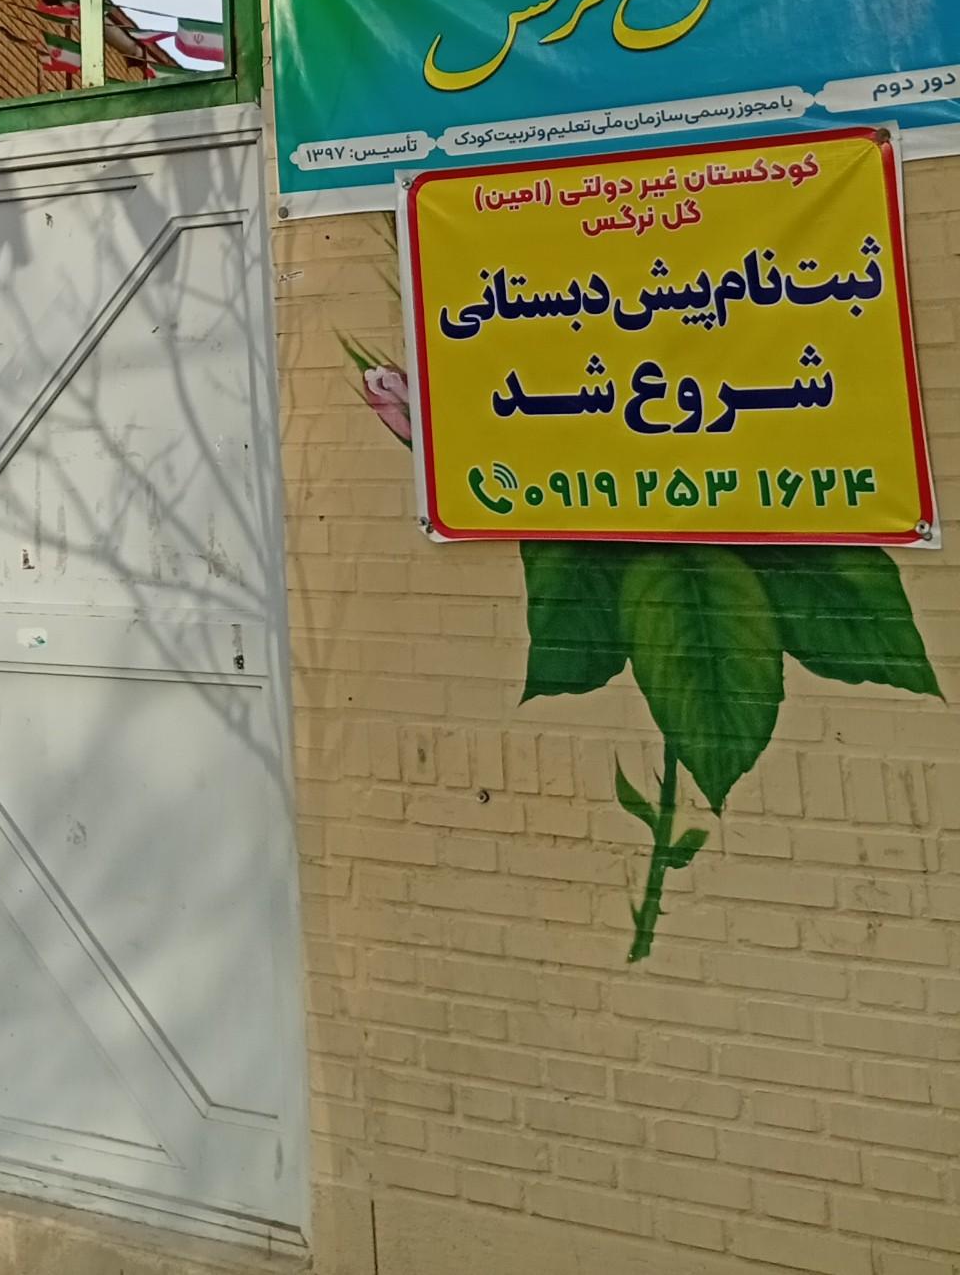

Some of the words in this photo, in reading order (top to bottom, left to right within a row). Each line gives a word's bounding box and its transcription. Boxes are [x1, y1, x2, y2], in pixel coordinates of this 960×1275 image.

[872, 78, 914, 100] دوم
[919, 72, 957, 94] دور
[684, 103, 737, 124] رسمی
[736, 98, 780, 118] مجوز
[779, 94, 793, 112] با
[493, 125, 538, 144] تربیت
[537, 128, 547, 141] و
[546, 118, 591, 142] تعلیم
[624, 110, 685, 131] سازمان
[453, 129, 495, 147] کودک
[305, 145, 346, 163] ۱۳۹۷
[638, 168, 677, 200] غیر
[684, 153, 820, 192] کودکستان
[558, 175, 633, 207] دولتی
[581, 204, 655, 237] نرگس
[661, 199, 702, 230] گل
[714, 248, 783, 327] نام
[784, 235, 882, 318] ثبت
[439, 267, 611, 339] دبستانی
[613, 257, 713, 331] پیش
[490, 353, 616, 418] شد
[623, 343, 835, 434] شروع
[524, 470, 619, 508] ۰۹۱۹
[635, 467, 738, 508] ۲۵۳
[756, 467, 876, 509] ۱۶۲۴
